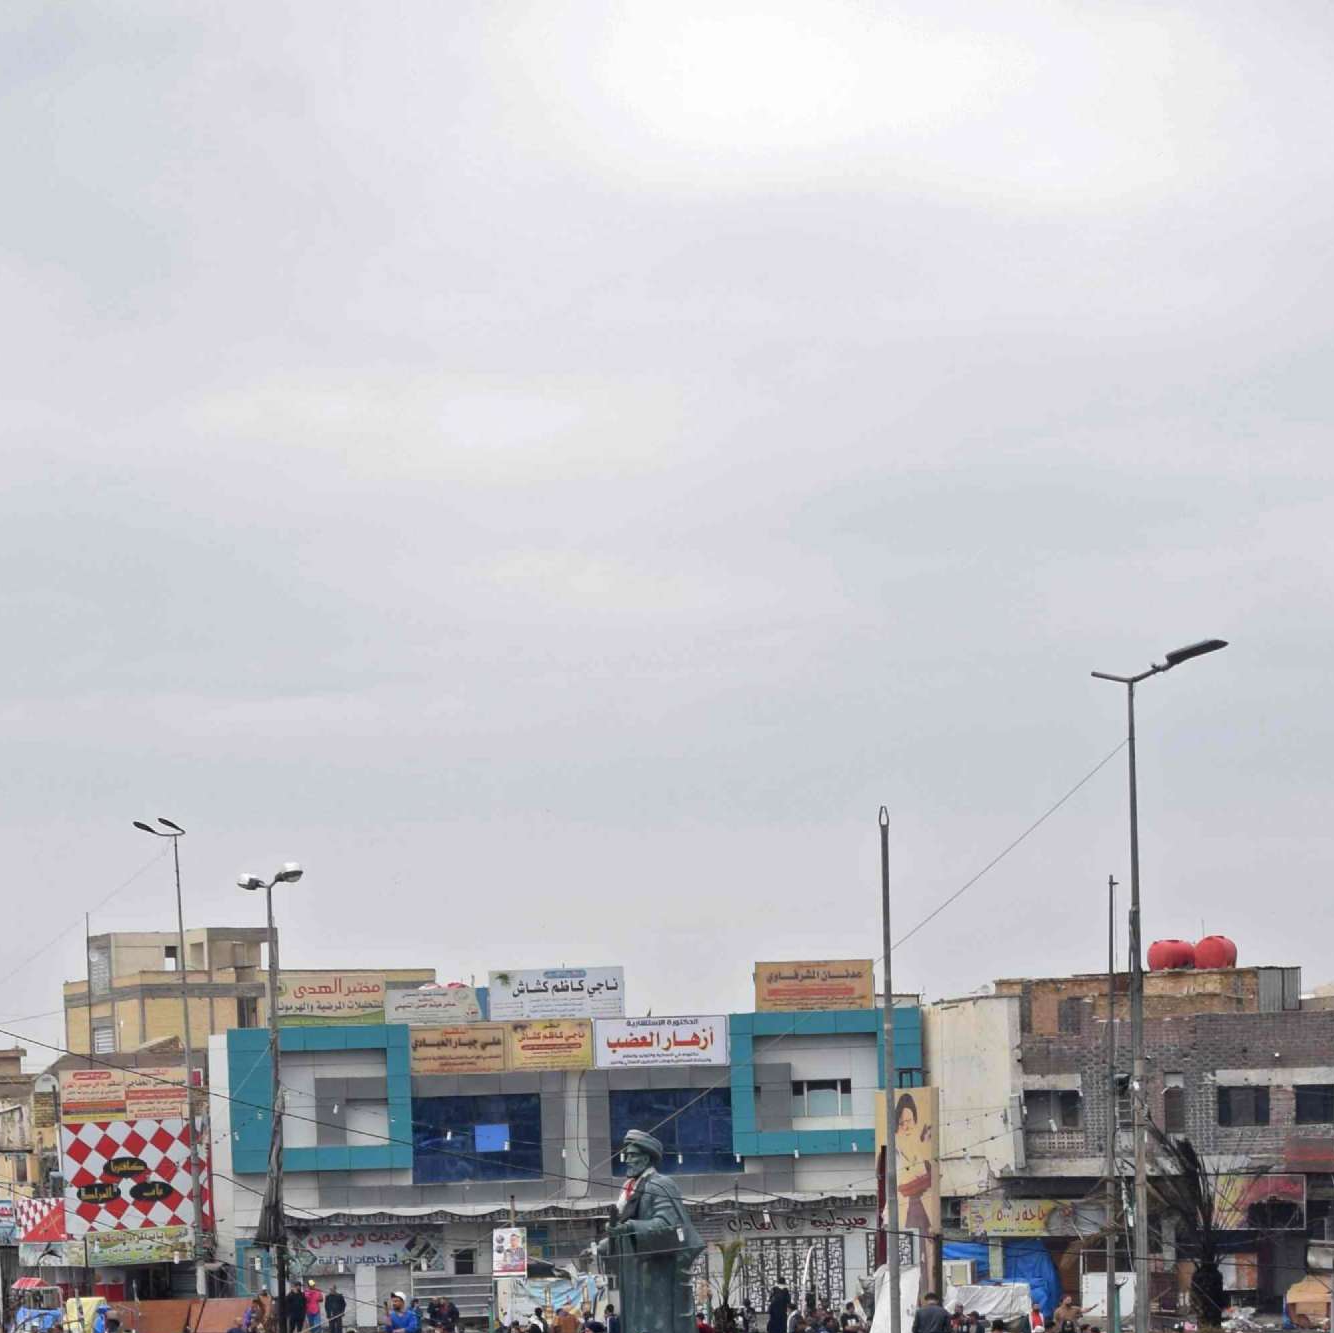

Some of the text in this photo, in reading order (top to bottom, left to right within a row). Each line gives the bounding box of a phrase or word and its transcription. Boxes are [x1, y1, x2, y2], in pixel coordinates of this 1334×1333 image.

[344, 978, 386, 998] مختبر
[512, 977, 619, 998] ناجي كاظم كشاش
[480, 1037, 502, 1051] علي
[662, 1026, 714, 1051] أزهار
[810, 1210, 868, 1232] صيدلية
